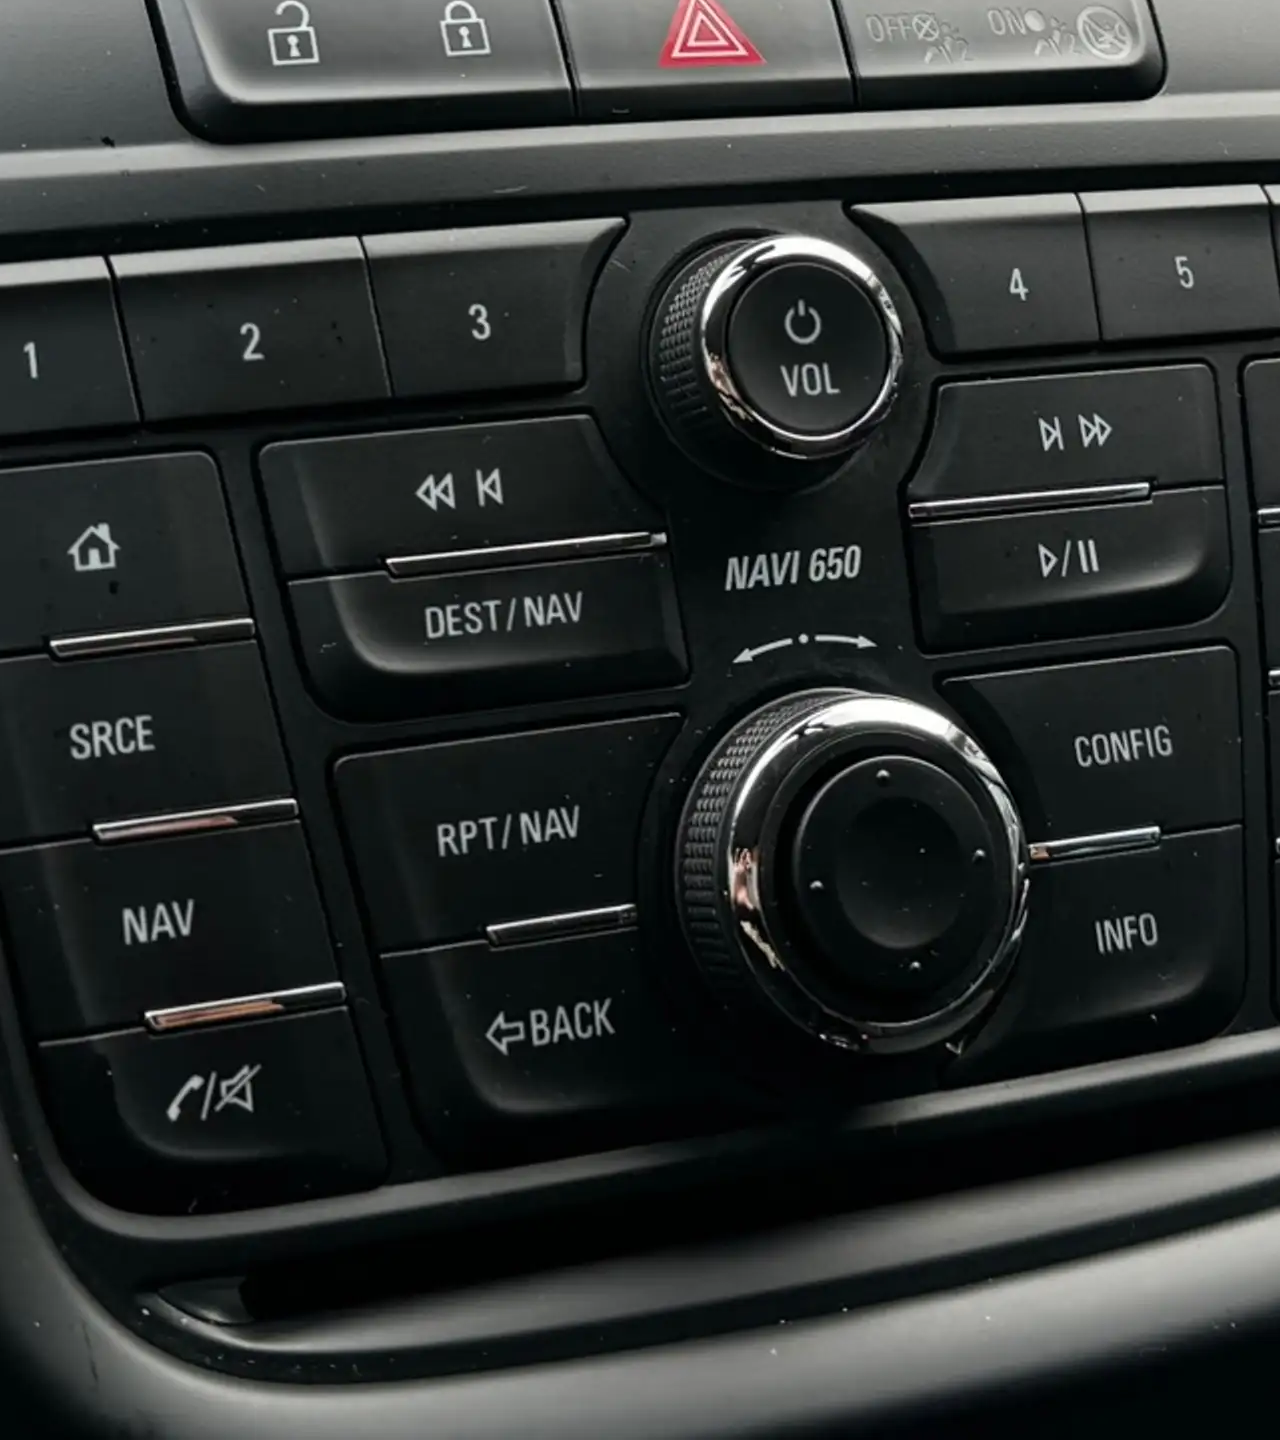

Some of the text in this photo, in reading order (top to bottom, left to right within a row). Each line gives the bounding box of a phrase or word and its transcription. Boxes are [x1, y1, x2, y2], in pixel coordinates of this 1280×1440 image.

[865, 13, 913, 44] OFF
[986, 7, 1026, 37] ON
[1009, 267, 1030, 302] 4
[1174, 256, 1195, 289] 5
[467, 304, 491, 340] 3
[22, 341, 39, 379] 1
[239, 323, 264, 361] 2
[780, 361, 841, 398] VOL
[725, 543, 863, 592] NAVI 650
[69, 715, 156, 760] SRCE
[1074, 724, 1173, 768] CONFIG
[122, 898, 196, 946] NAV
[1094, 912, 1159, 955] INFO
[530, 997, 617, 1047] BACK
